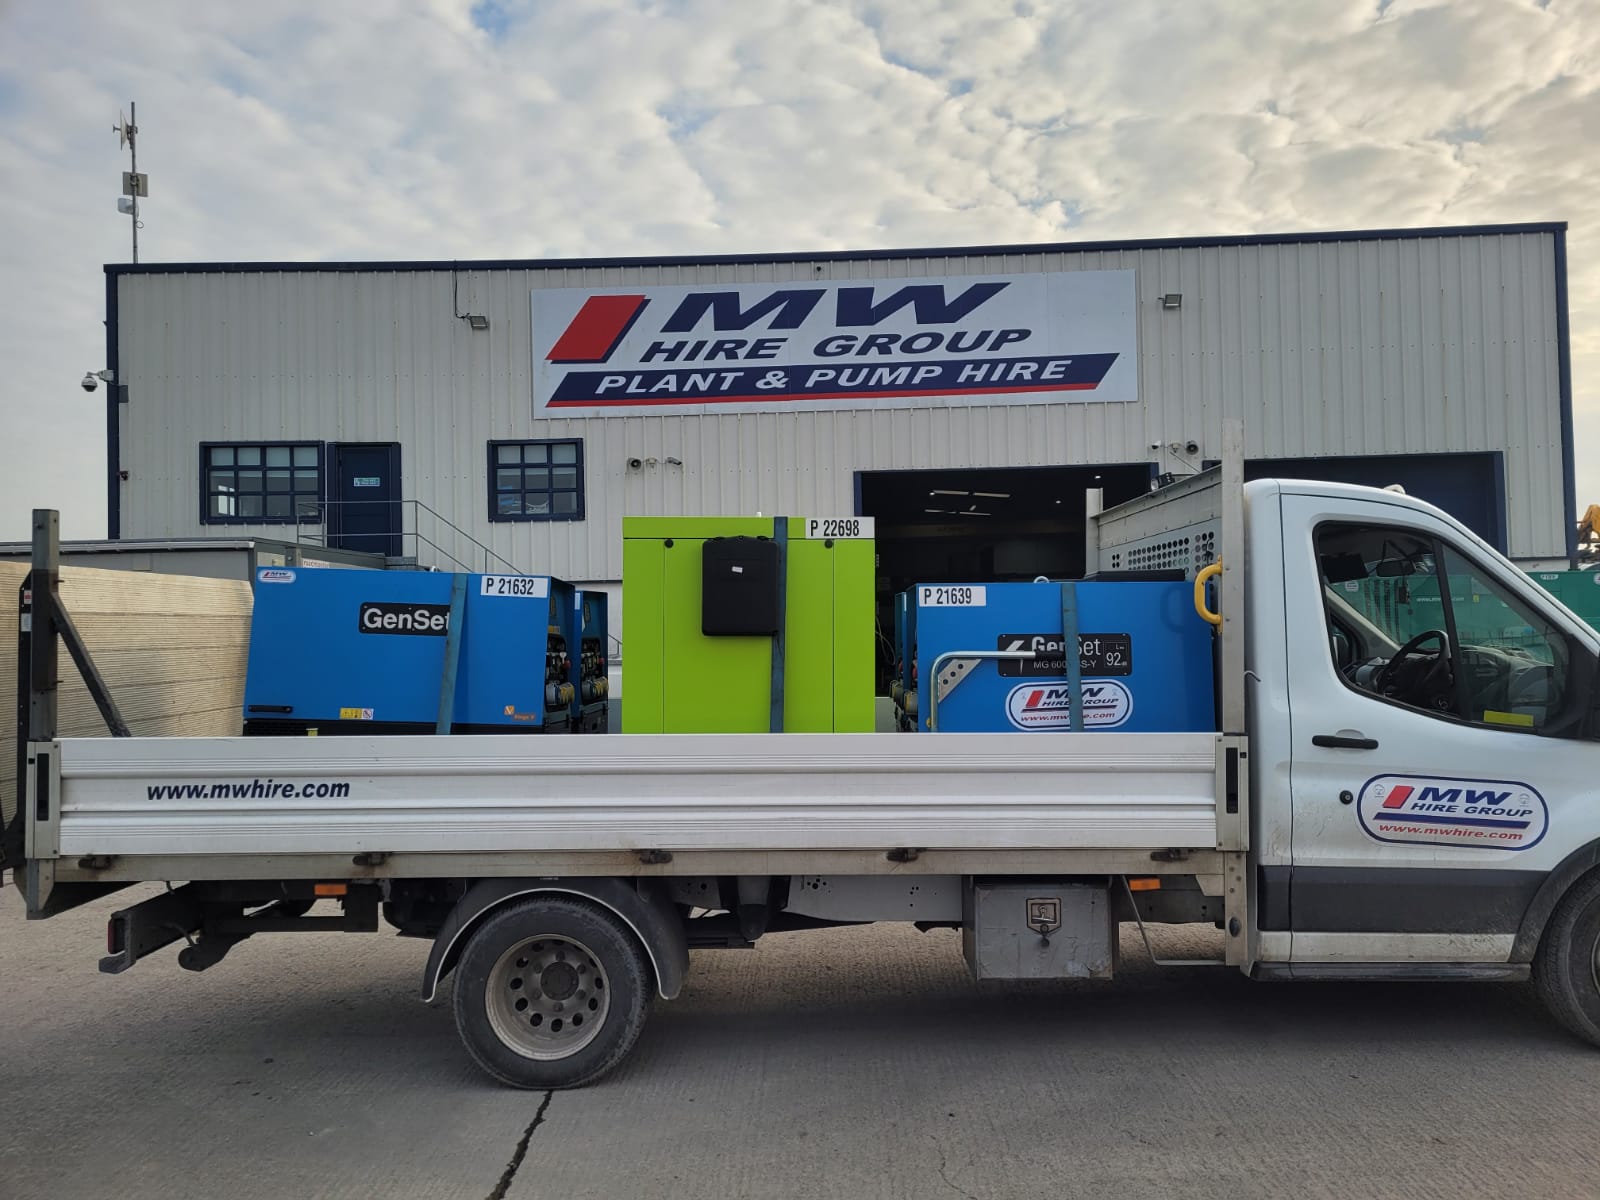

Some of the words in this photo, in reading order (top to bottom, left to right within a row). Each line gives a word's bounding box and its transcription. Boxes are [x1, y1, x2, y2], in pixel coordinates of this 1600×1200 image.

[659, 282, 1012, 333] MW
[638, 337, 789, 363] HIRE
[813, 328, 1033, 358] GROUP
[594, 371, 745, 395] PLANT
[755, 370, 790, 389] &
[804, 365, 943, 388] PUMP
[956, 359, 1073, 384] HIRE
[810, 519, 819, 537] P
[823, 519, 860, 537] 22698
[485, 577, 495, 594] P
[498, 577, 535, 596] 21632
[924, 588, 932, 605] P
[936, 587, 973, 605] 21639
[363, 607, 451, 631] GenSet
[1031, 636, 1102, 656] Geet
[1033, 660, 1050, 669] MG
[1106, 652, 1121, 666] 92
[147, 778, 350, 801] www.mwhire.com
[1417, 786, 1513, 806] MW
[1410, 802, 1460, 813] HIRE
[1463, 806, 1534, 818] GROUP
[1379, 823, 1523, 841] www.mwhire.com
